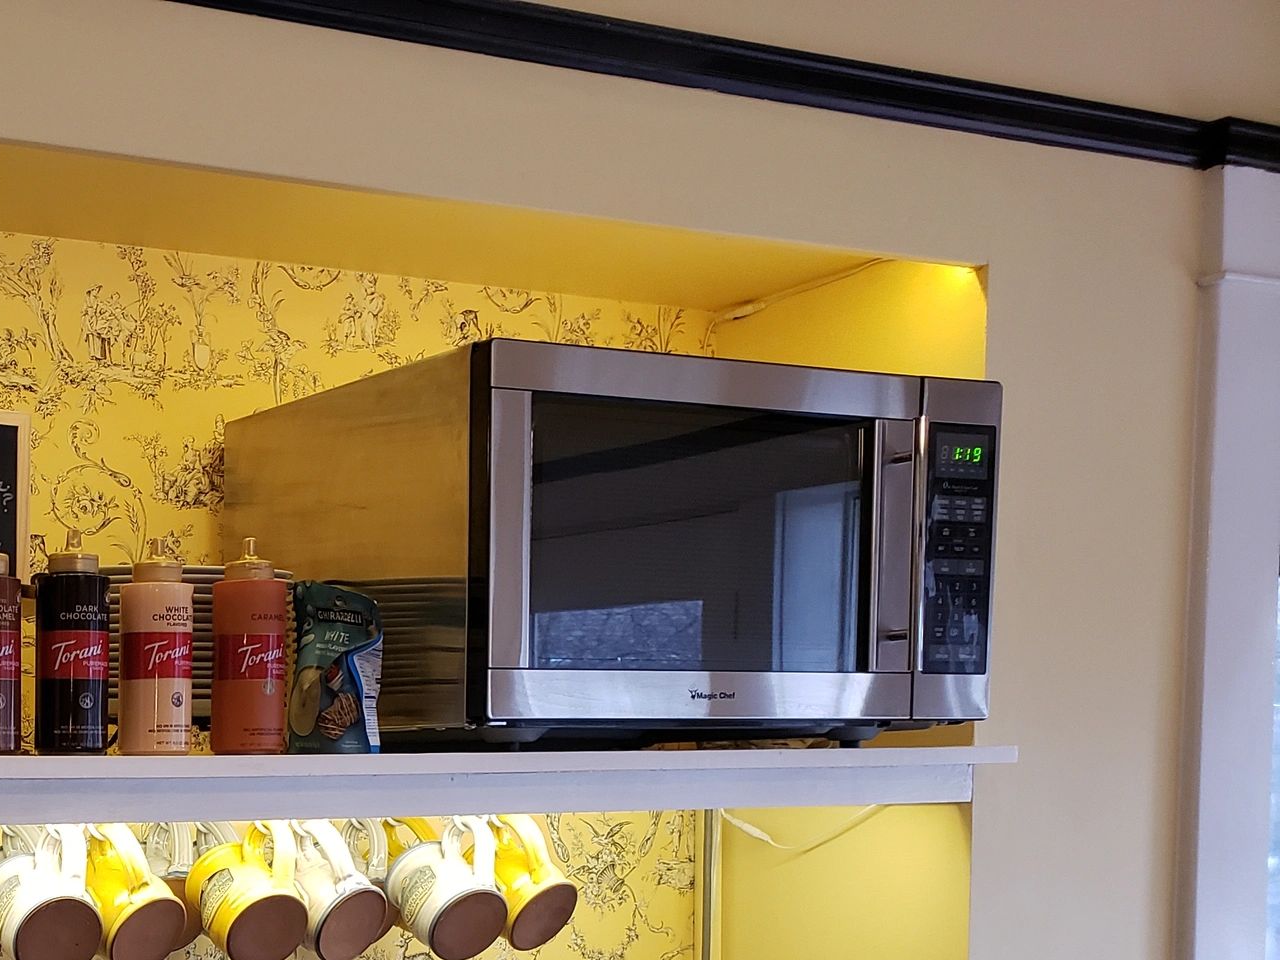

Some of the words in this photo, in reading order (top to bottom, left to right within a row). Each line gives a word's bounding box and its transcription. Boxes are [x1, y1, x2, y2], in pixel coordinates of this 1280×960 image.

[953, 447, 982, 462] 1:19
[75, 604, 99, 613] DARK
[165, 606, 189, 614] WHITE
[60, 612, 108, 621] CHOCOLATE
[51, 639, 103, 671] Torani
[144, 640, 190, 671] Torani
[238, 643, 284, 673] Torani
[696, 692, 718, 701] Magic
